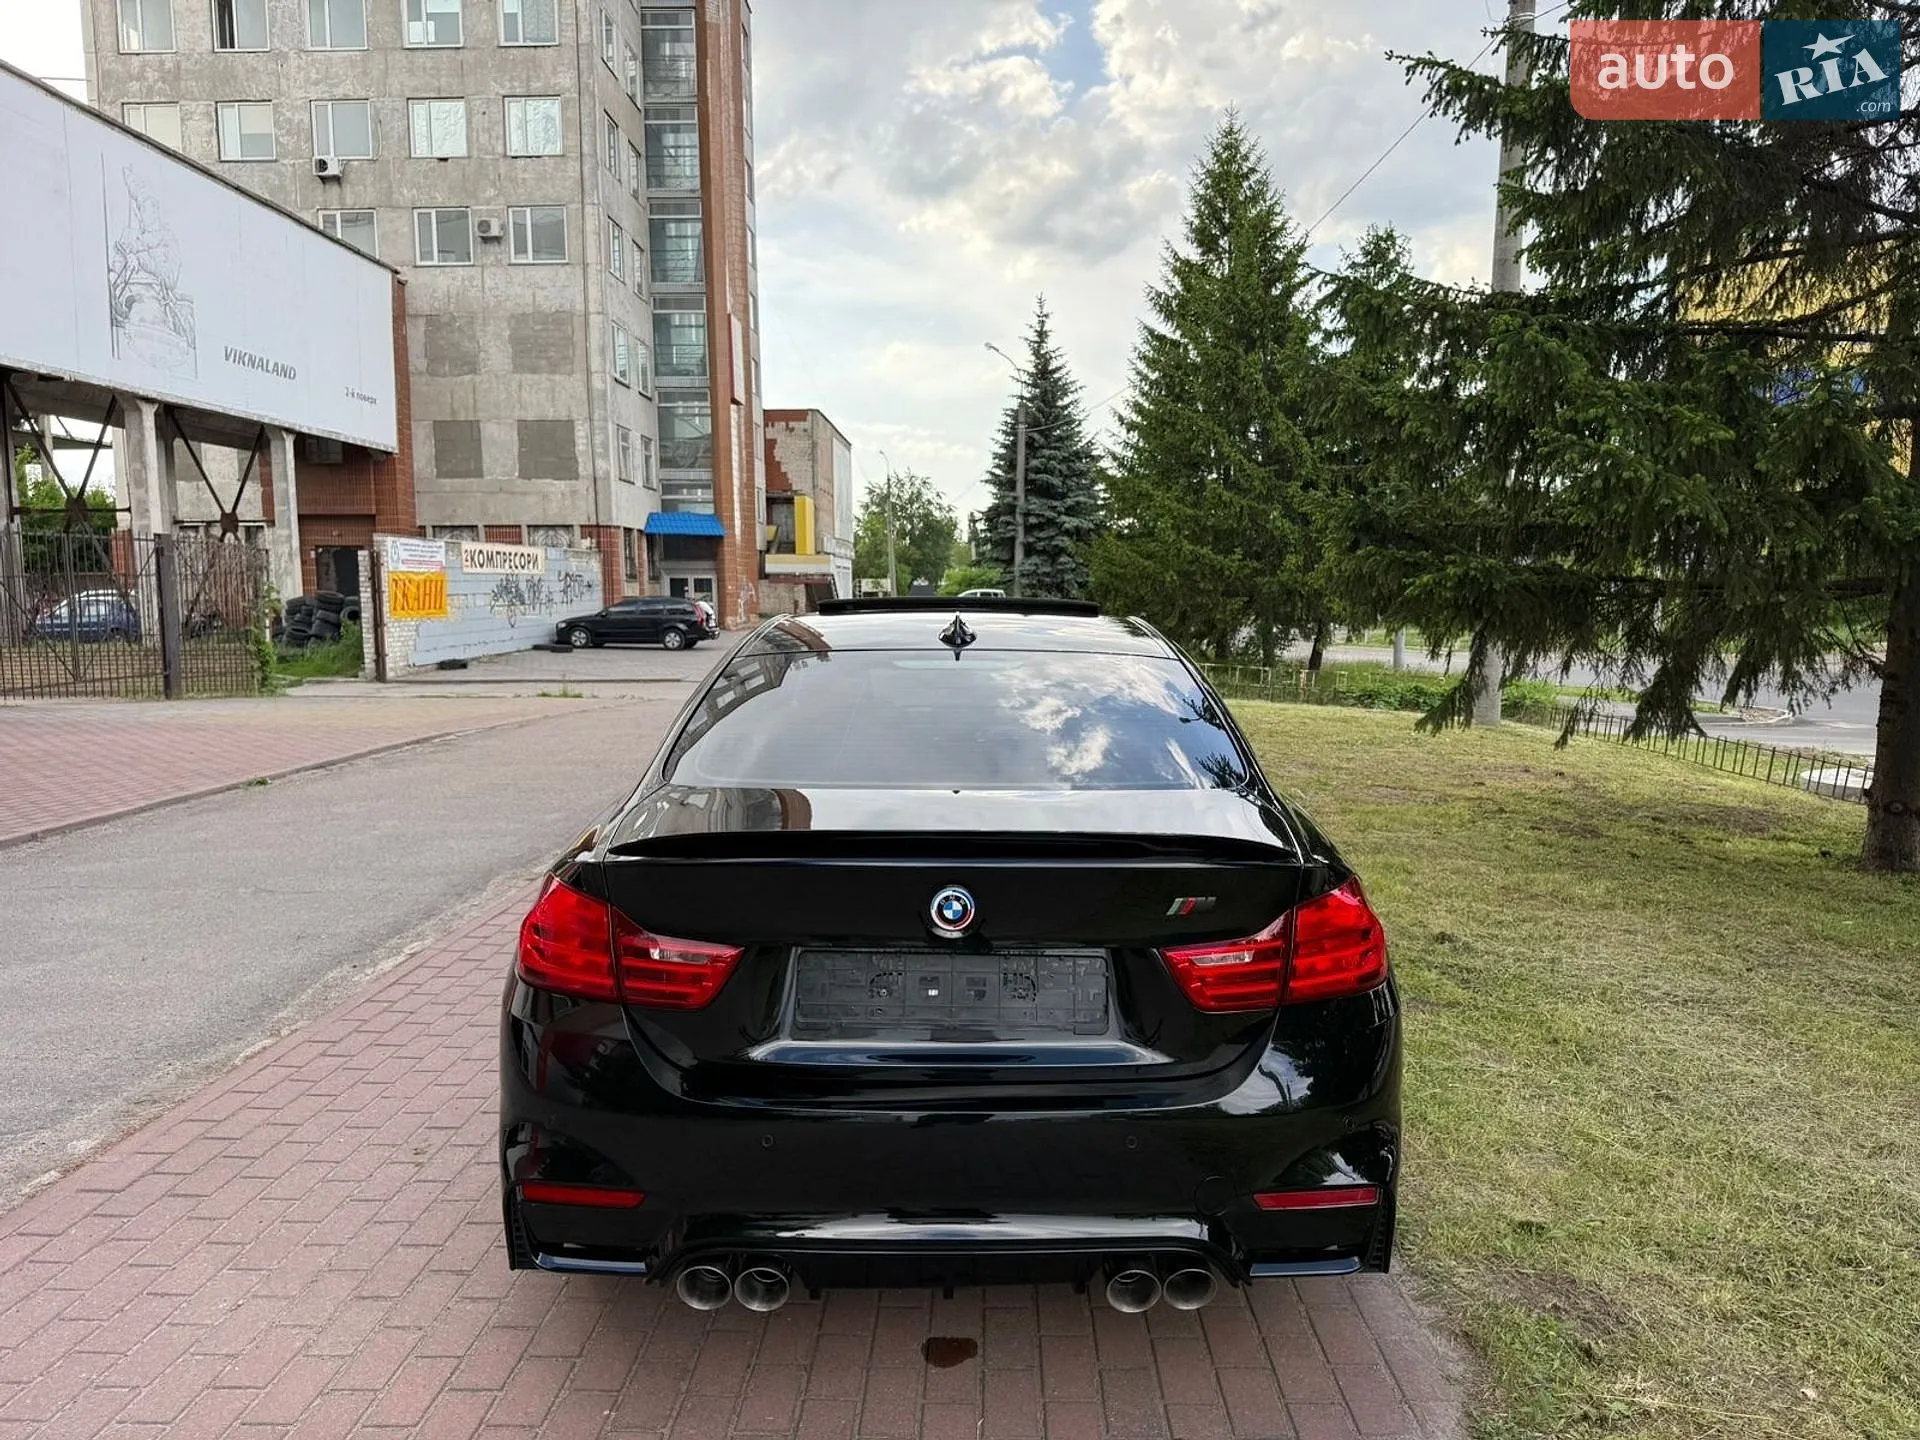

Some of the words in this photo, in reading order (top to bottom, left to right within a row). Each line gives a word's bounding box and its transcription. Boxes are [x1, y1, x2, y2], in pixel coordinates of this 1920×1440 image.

[224, 346, 296, 380] VIKNALAND
[470, 549, 539, 570] КОМПРЕСОРИ
[391, 578, 444, 610] ТКАНИ
